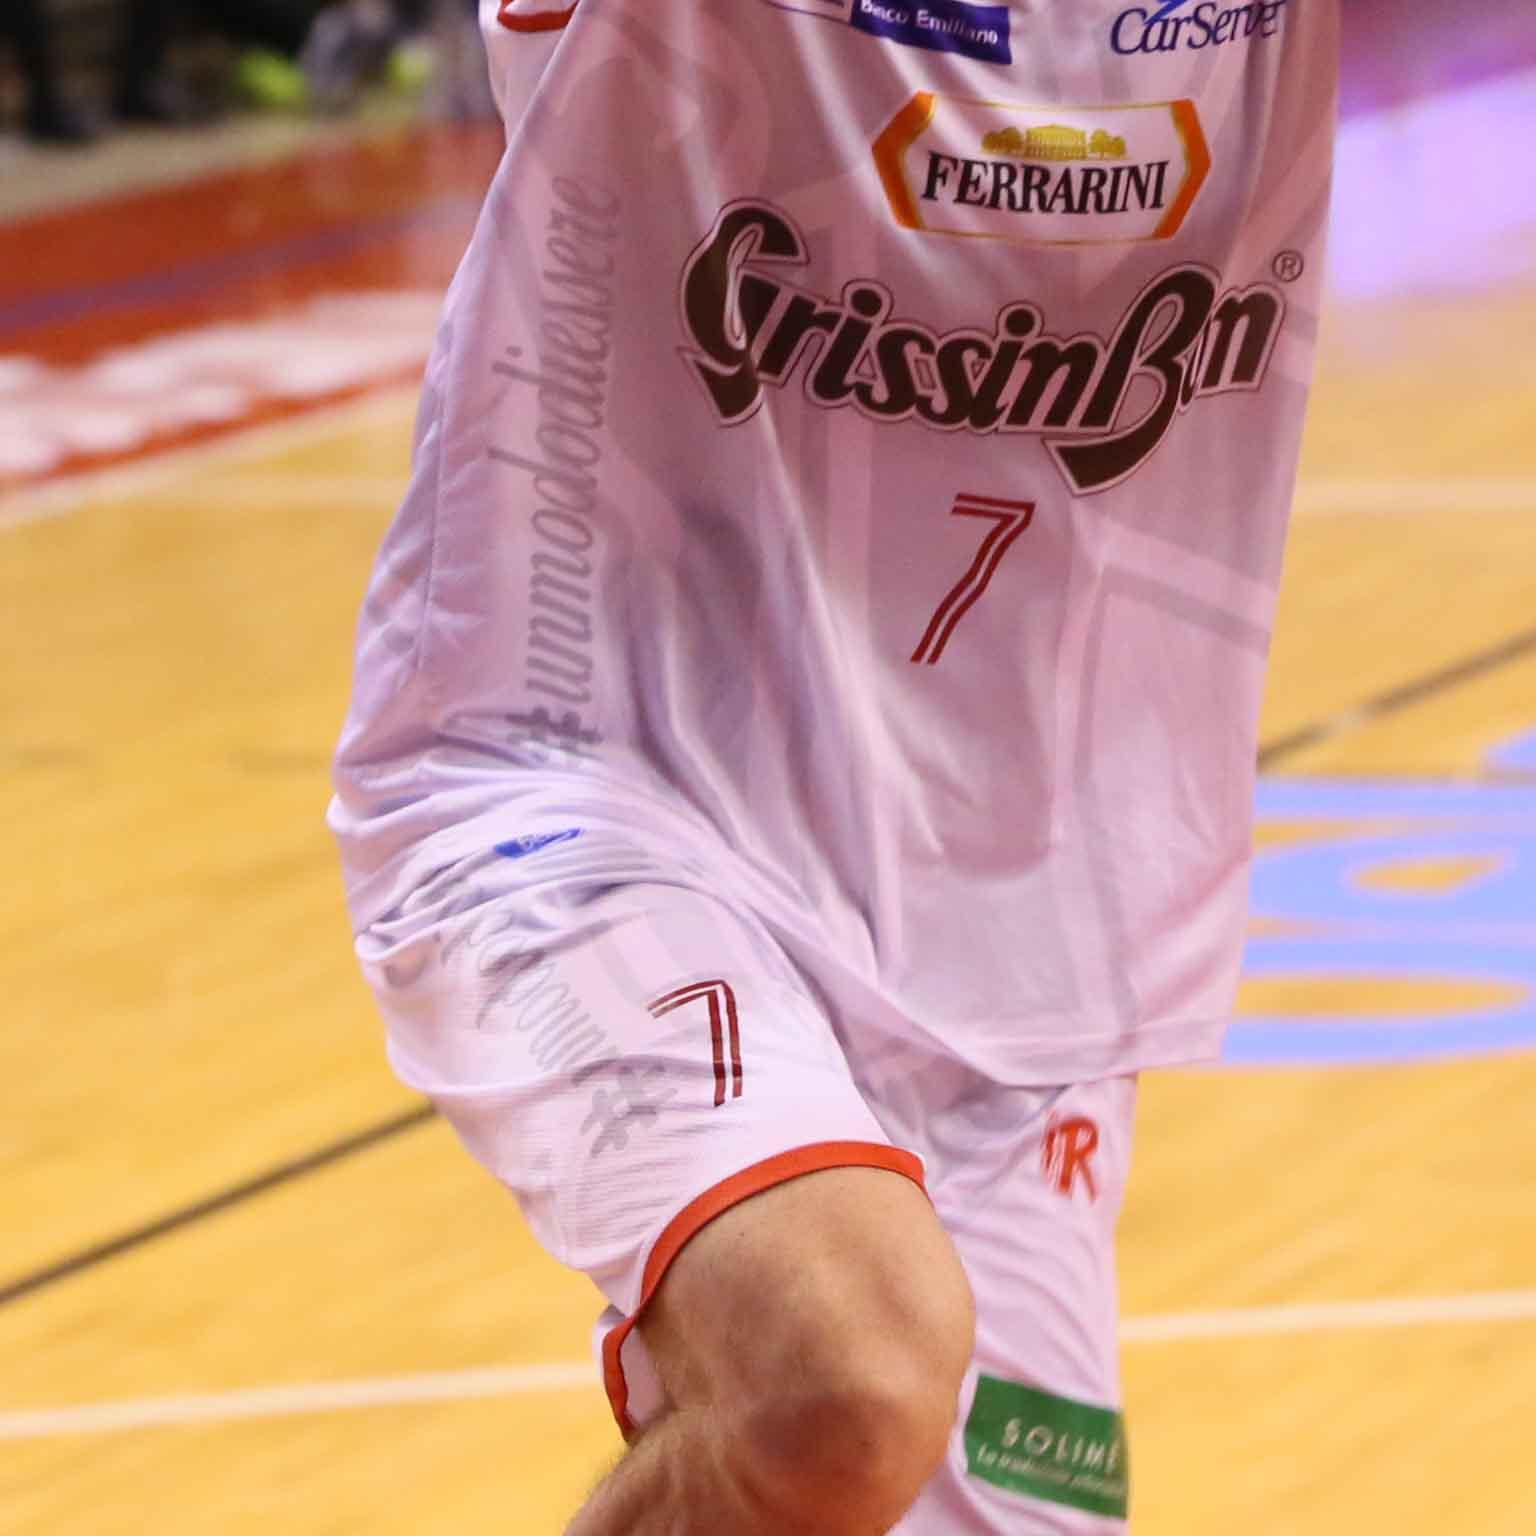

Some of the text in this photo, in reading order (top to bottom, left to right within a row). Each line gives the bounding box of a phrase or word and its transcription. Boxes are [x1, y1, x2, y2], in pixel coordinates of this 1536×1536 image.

[919, 149, 1171, 216] FERRARINI
[909, 492, 1036, 665] 7
[646, 978, 744, 1108] 7
